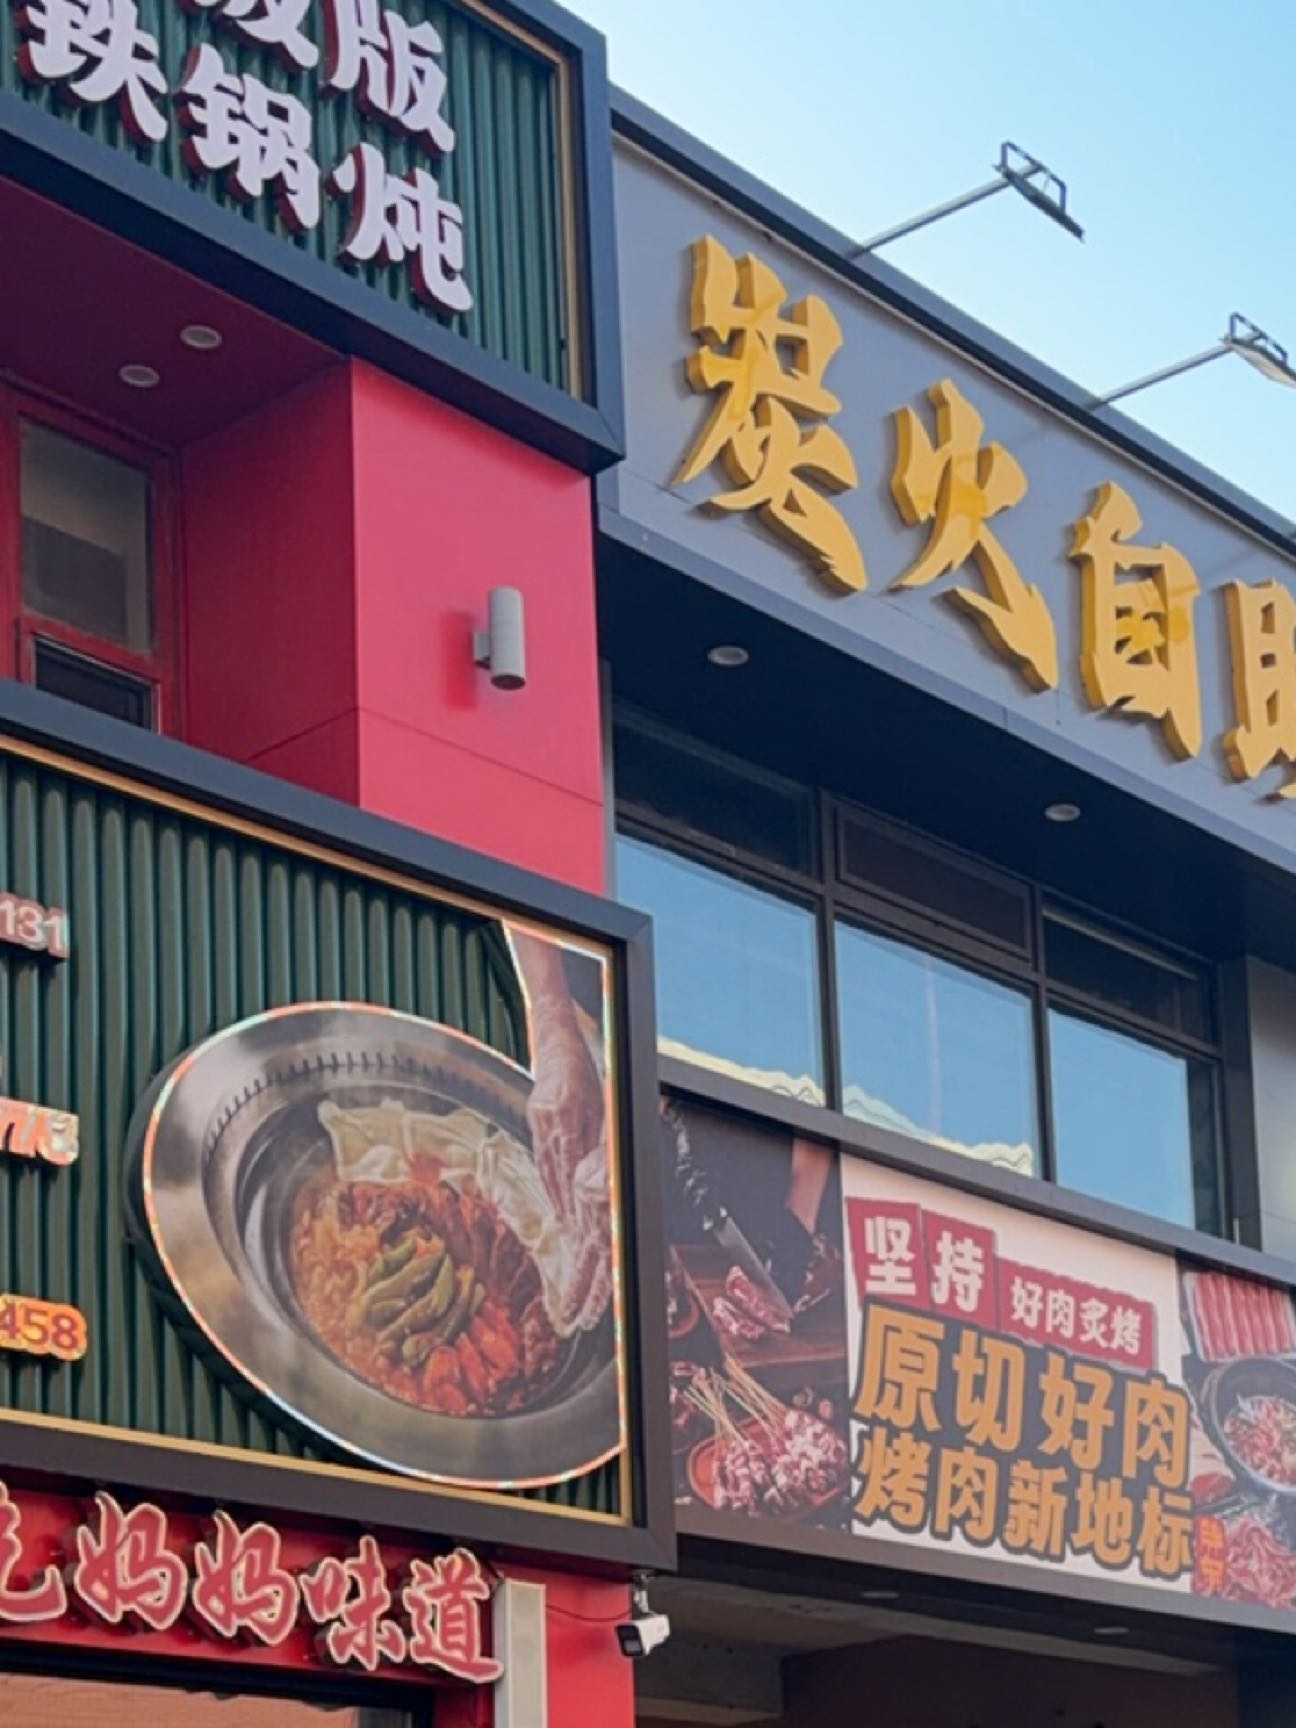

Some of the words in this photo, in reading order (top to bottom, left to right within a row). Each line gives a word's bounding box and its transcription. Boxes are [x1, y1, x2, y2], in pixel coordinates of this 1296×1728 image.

[16, 0, 472, 312] 铁锅炖
[0, 1302, 80, 1351] 458
[864, 1214, 986, 1312] 坚持
[1008, 1276, 1142, 1356] 好肉炙烤
[852, 1304, 1192, 1490] 原切好肉
[854, 1428, 1196, 1576] 烤肉新地标
